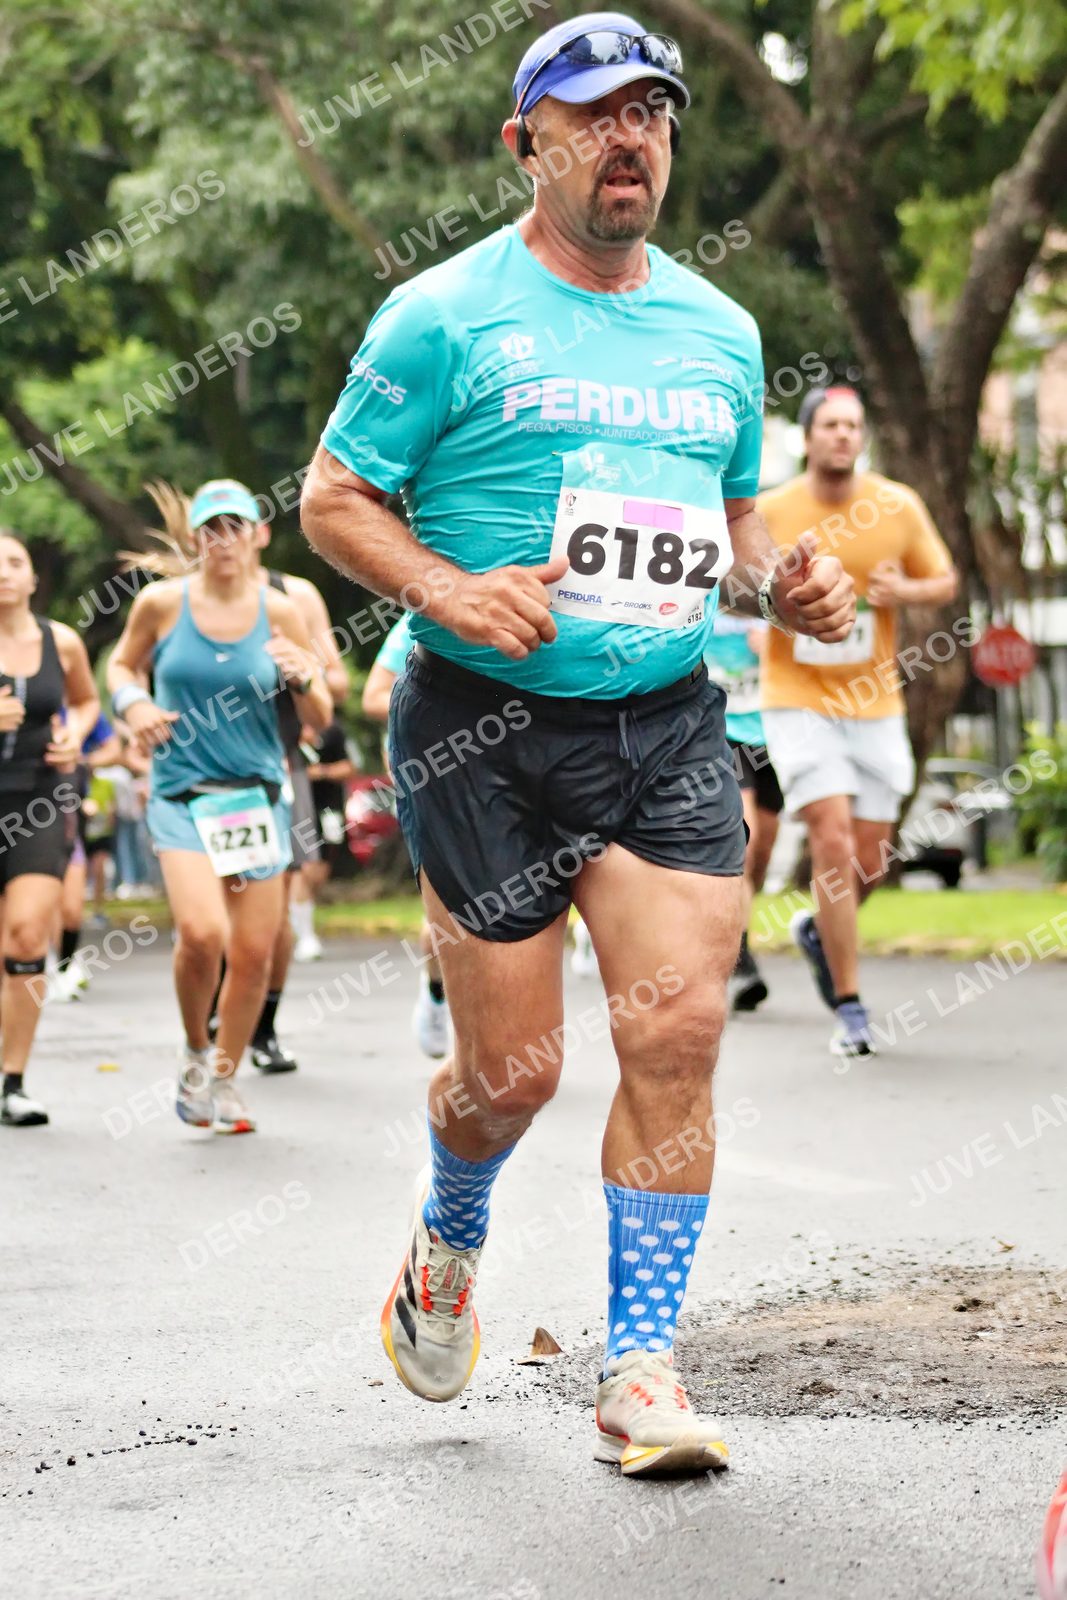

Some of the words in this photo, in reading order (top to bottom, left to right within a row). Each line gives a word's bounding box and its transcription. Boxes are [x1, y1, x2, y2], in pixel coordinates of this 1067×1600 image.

[502, 377, 737, 437] PERDURA
[517, 421, 551, 433] PEGA
[554, 422, 592, 435] PISOS
[567, 522, 720, 590] 6182
[557, 589, 603, 604] PERDURA
[623, 601, 653, 610] BROOKS
